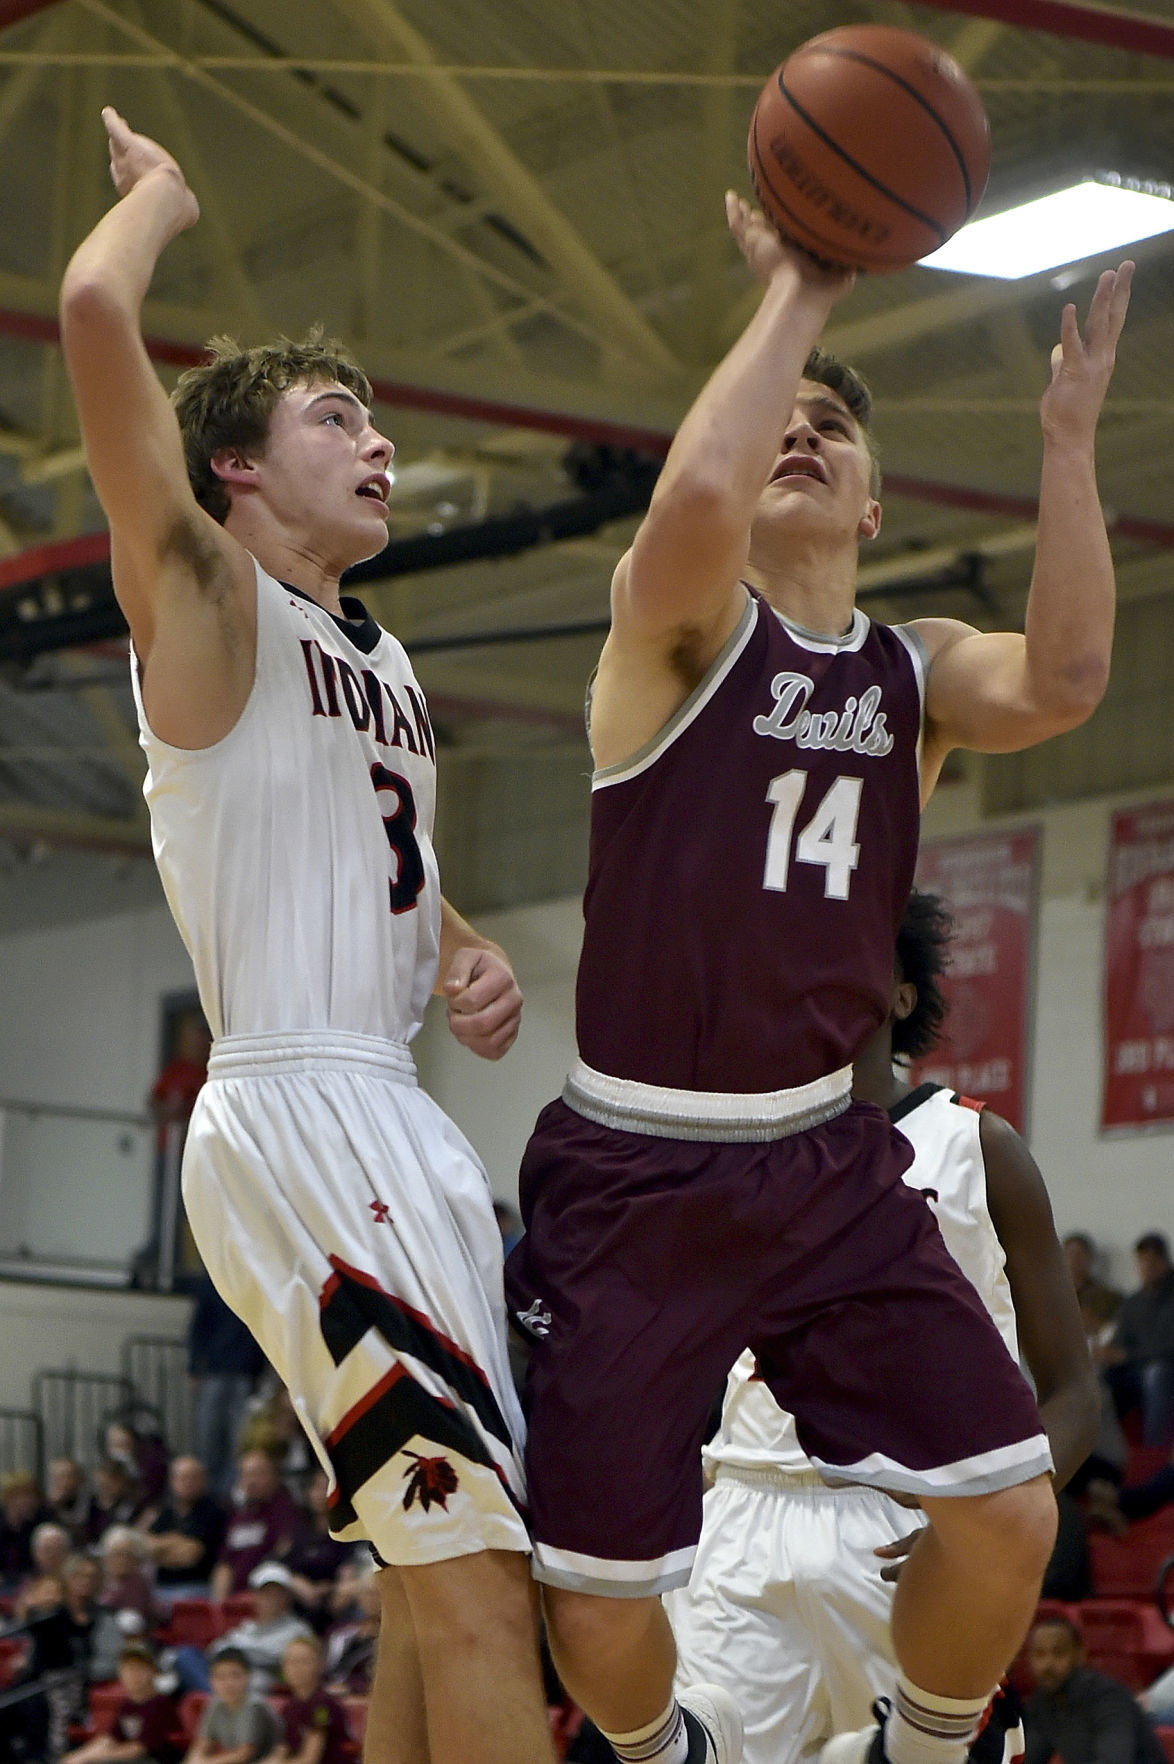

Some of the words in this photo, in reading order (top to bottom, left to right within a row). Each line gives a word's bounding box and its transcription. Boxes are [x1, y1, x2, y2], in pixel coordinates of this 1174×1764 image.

[752, 671, 895, 757] Devils
[370, 761, 426, 916] 3
[762, 767, 865, 901] 14
